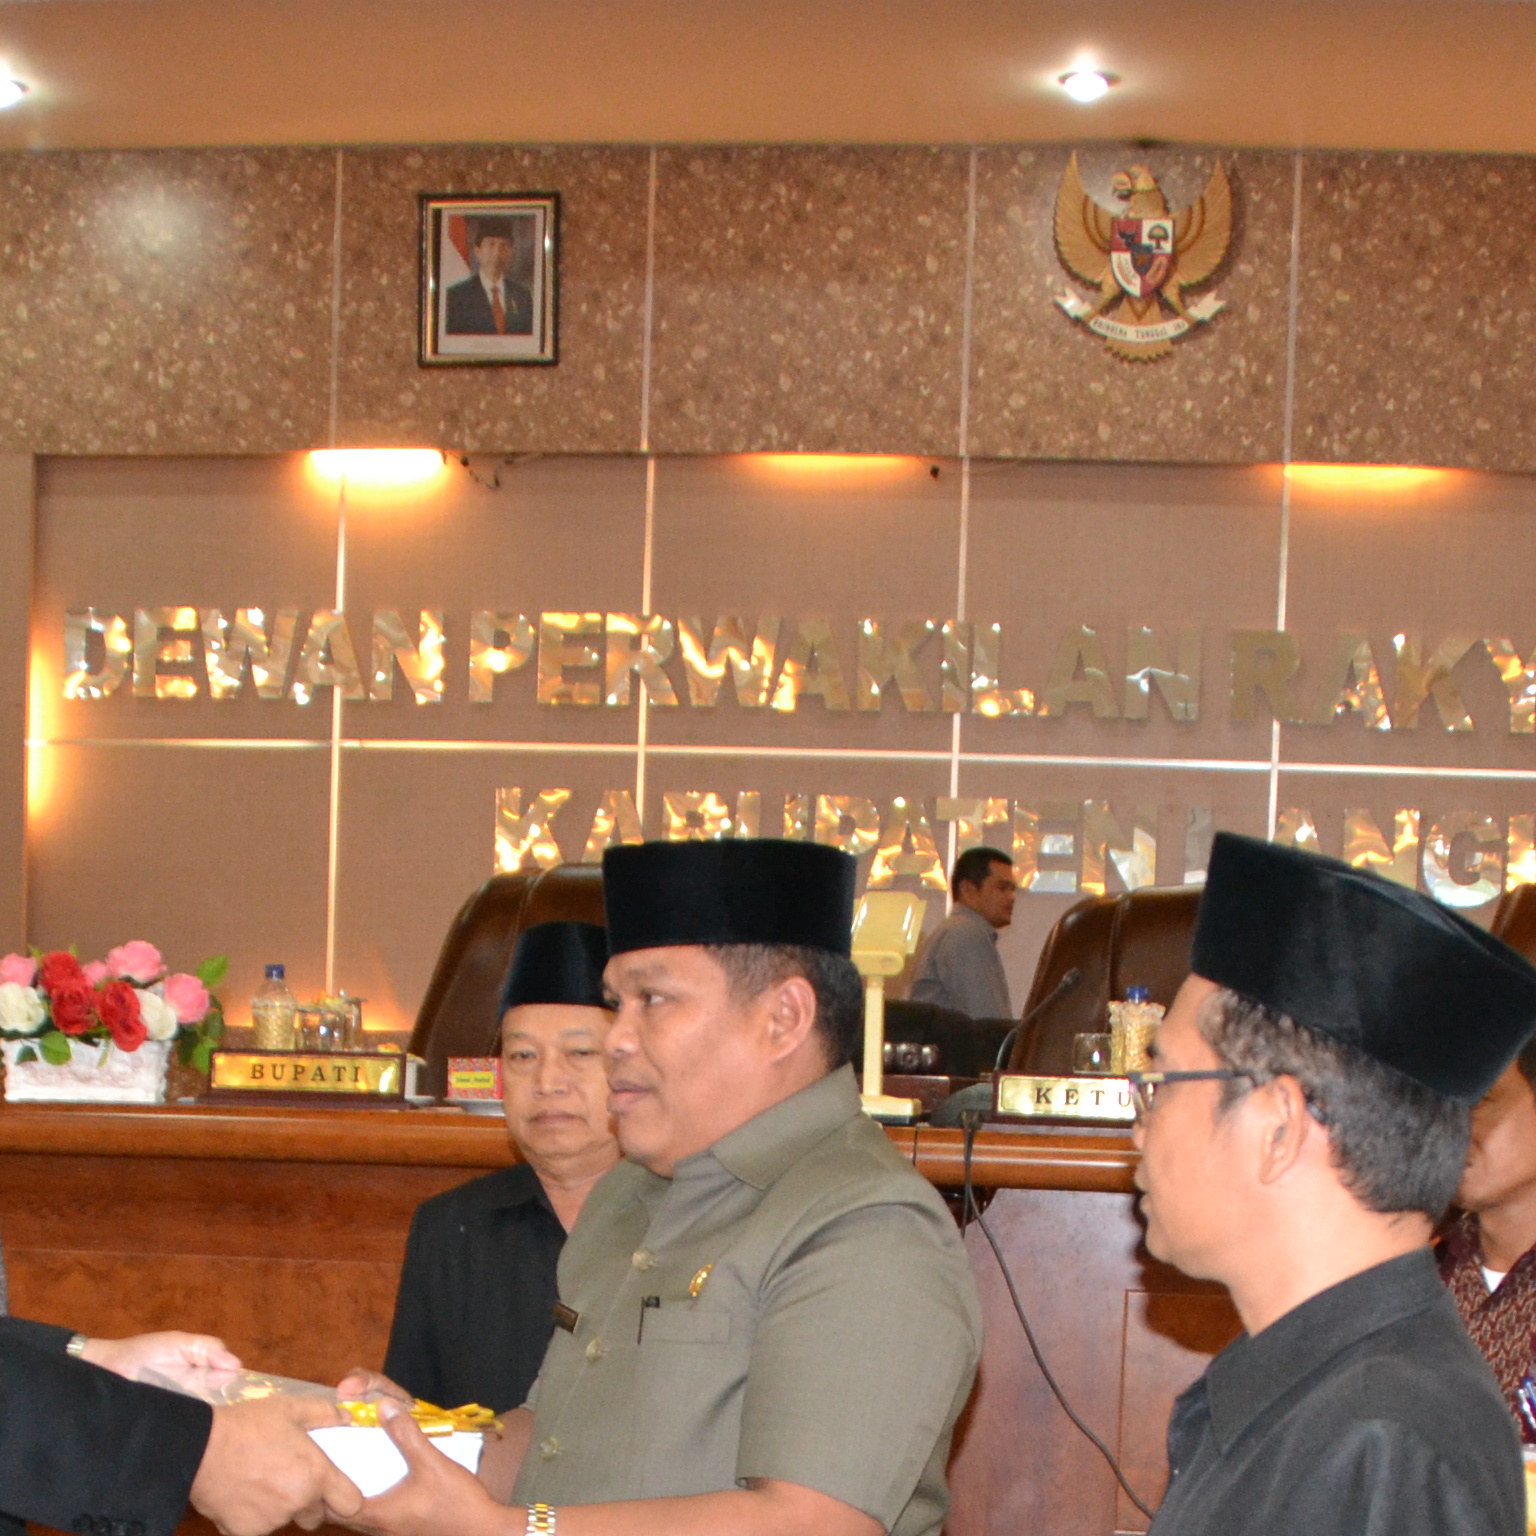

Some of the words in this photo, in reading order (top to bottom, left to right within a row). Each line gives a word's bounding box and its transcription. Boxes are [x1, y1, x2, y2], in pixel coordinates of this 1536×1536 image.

[62, 605, 444, 704] DEWAN
[468, 606, 1202, 720] PERWAKILAN
[250, 1063, 361, 1083] BUPATI
[1035, 1086, 1132, 1108] KETU
